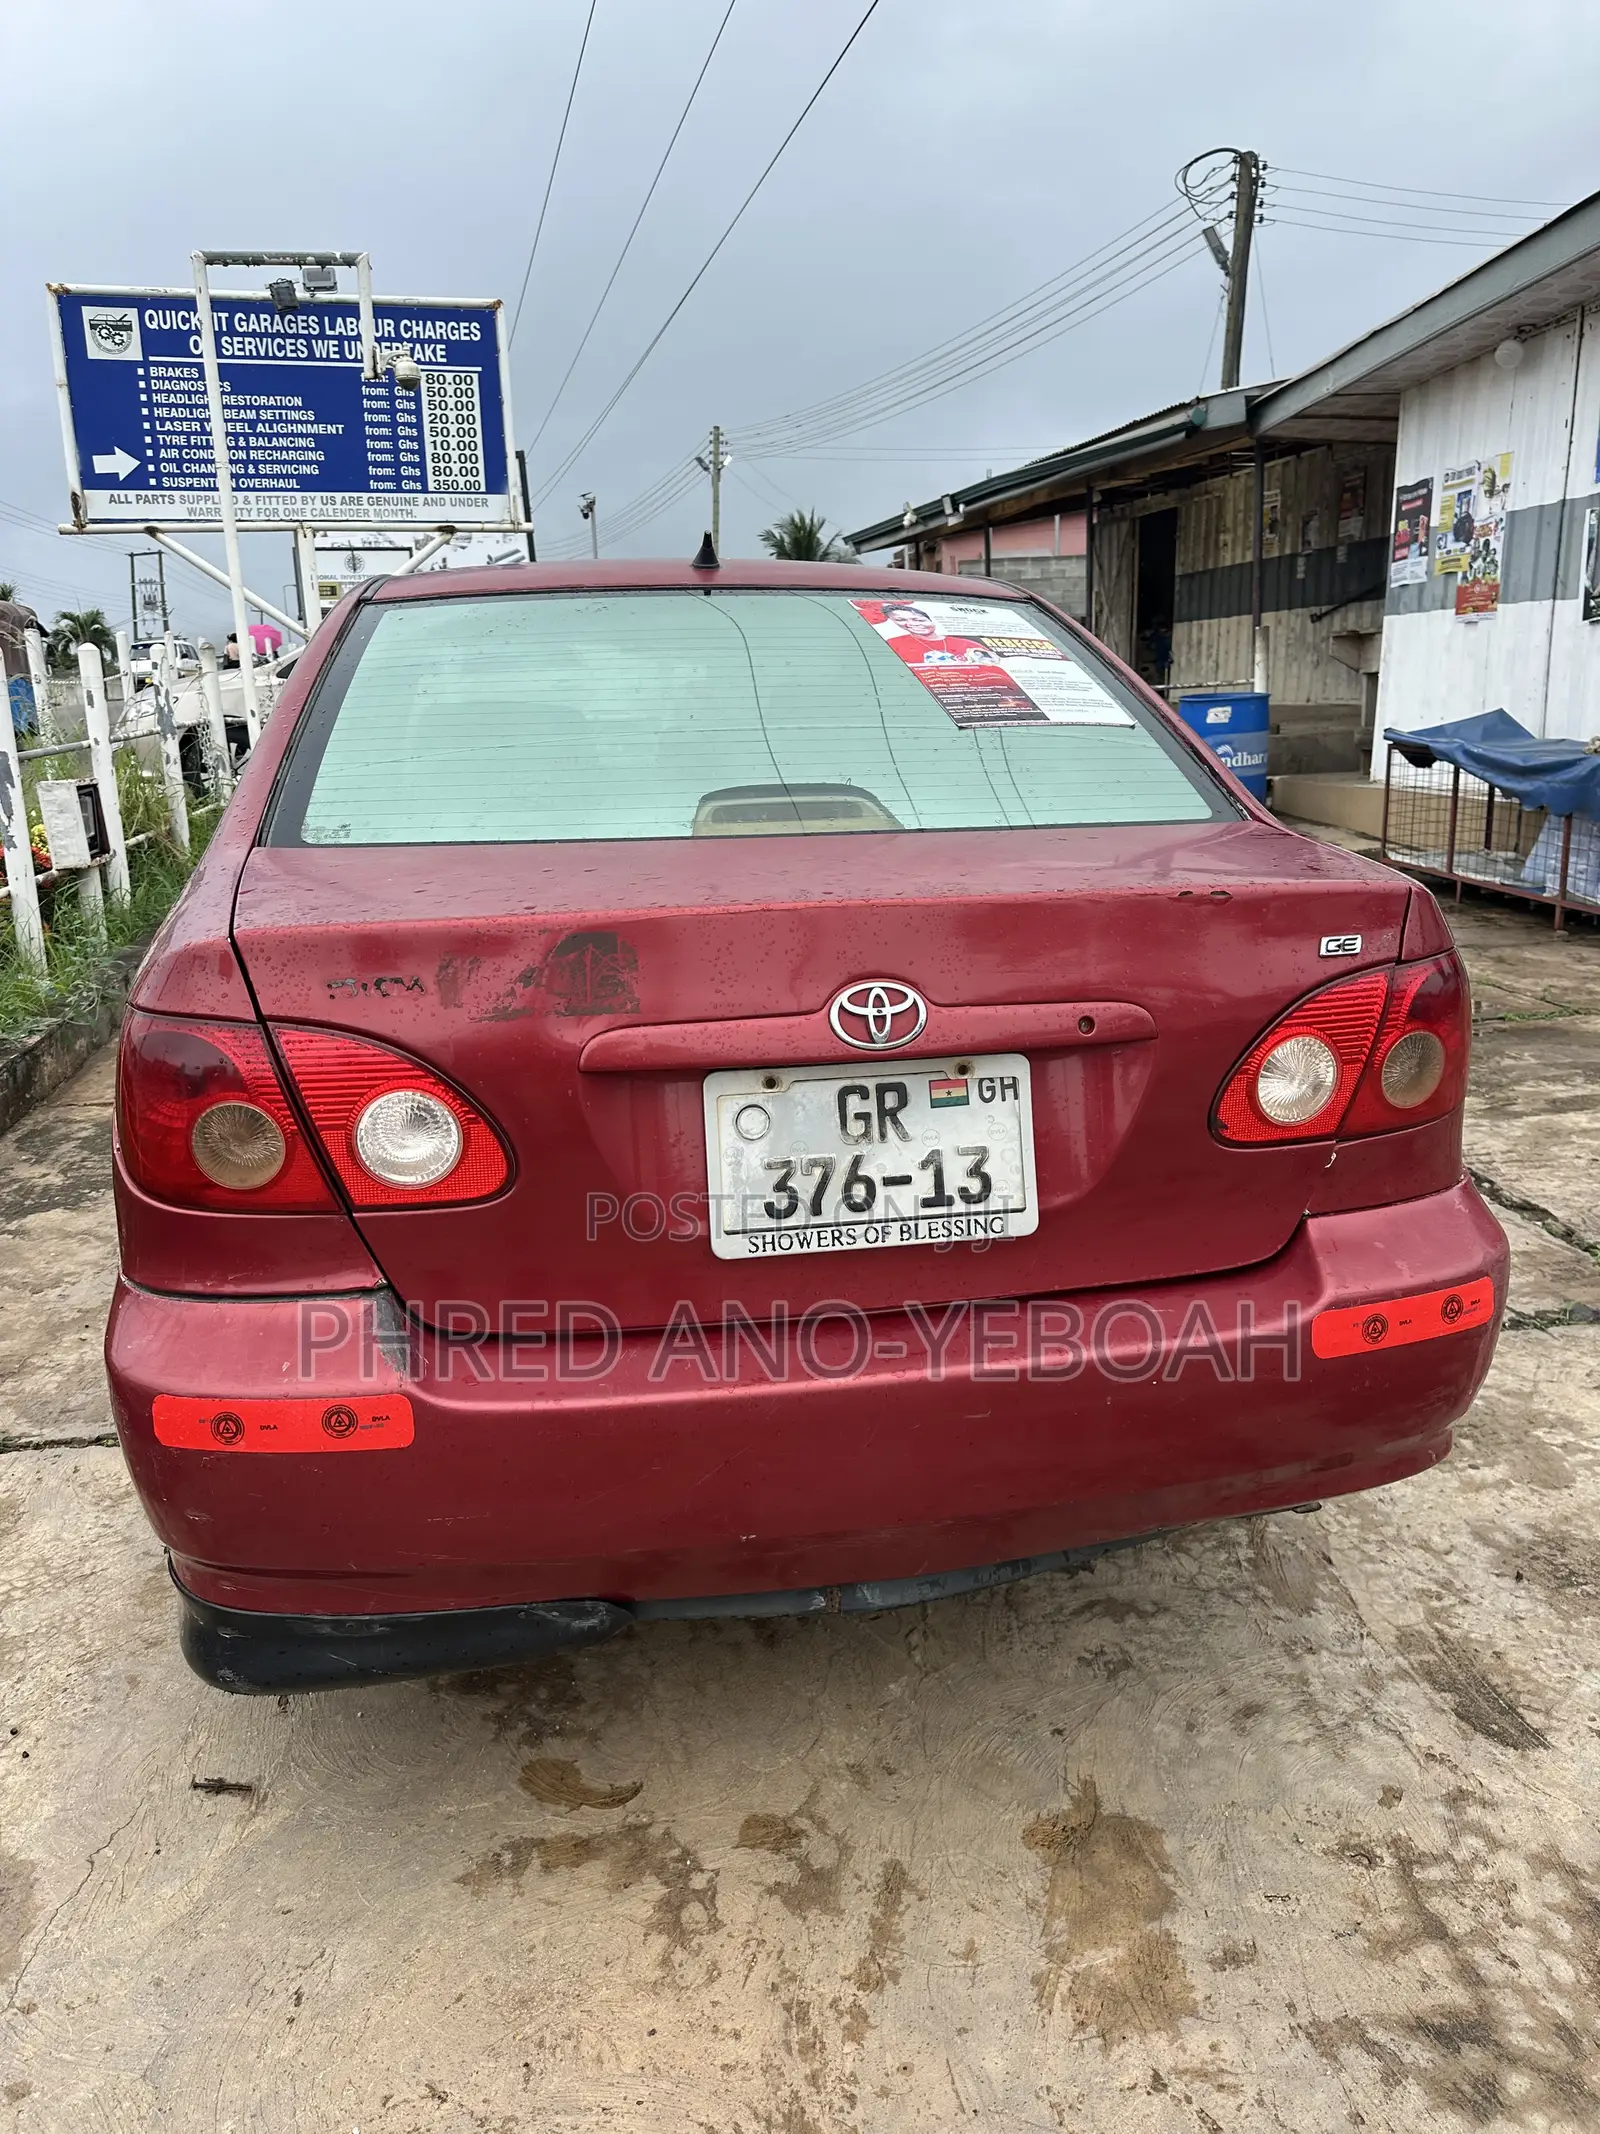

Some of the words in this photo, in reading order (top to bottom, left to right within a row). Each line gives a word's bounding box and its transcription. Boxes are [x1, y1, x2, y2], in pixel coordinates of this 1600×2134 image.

[144, 309, 229, 332] QUICKIT
[233, 312, 320, 335] GARAGES
[324, 316, 395, 338] LABUR
[400, 319, 481, 342] CHARGES
[189, 335, 206, 355] O
[221, 336, 308, 359] SERVICES
[312, 339, 341, 360] WE
[149, 366, 199, 378] BRAKES
[425, 373, 474, 386] 80.00
[361, 386, 389, 396] from:
[426, 387, 475, 398] 50.00
[152, 393, 210, 405] HEADLIGH
[222, 395, 302, 407] RESTORATION
[363, 399, 390, 409] from:
[395, 399, 416, 410] Ghs
[427, 400, 476, 412] 50.00
[154, 407, 212, 418] HEADLIGH
[223, 409, 256, 420] BEAM
[259, 410, 315, 421] SETTINGS
[364, 412, 391, 423] from:
[396, 412, 417, 423] Ghs
[428, 413, 477, 425] 20.00
[156, 420, 201, 431] LASER
[256, 423, 345, 434] ALIGHNMENT
[365, 425, 392, 436] from:
[397, 425, 418, 437] Ghs
[429, 426, 478, 439] 50.00
[157, 435, 188, 446] TYRE
[190, 436, 236, 447] FITTG
[238, 437, 247, 447] &
[248, 437, 316, 448] BALANCING
[366, 439, 393, 449] from:
[398, 439, 419, 450] Ghs
[430, 440, 478, 452] 10.00
[159, 448, 179, 459] AIR
[249, 450, 325, 461] RECHARGING
[367, 452, 394, 462] from:
[399, 452, 420, 463] Ghs
[431, 453, 479, 465] 80.00
[160, 463, 181, 473] OIL
[183, 463, 245, 474] CHANNG
[247, 464, 256, 474] &
[258, 464, 319, 475] SERVICING
[368, 466, 395, 476] from:
[400, 466, 421, 477] Ghs
[432, 466, 480, 478] 80.00
[162, 477, 236, 488] SUSPENTIN
[238, 478, 301, 489] OVERHAUL
[369, 480, 397, 490] from:
[401, 480, 422, 490] Ghs
[433, 479, 482, 491] 350.00
[108, 493, 133, 505] ALL
[135, 494, 175, 505] PARTS
[179, 494, 239, 506] SUPPLID
[243, 496, 251, 506] &
[255, 495, 297, 506] FITTED
[301, 496, 316, 506] BY
[320, 496, 337, 507] US
[340, 496, 364, 507] ARE
[367, 496, 420, 507] GENUINE
[422, 497, 446, 508] AND
[450, 497, 489, 508] UNDER
[187, 507, 253, 518] WARRTY
[256, 508, 280, 518] FOR
[283, 508, 307, 518] ONE
[310, 508, 370, 519] CALENDER
[373, 508, 417, 519] MONTH.
[837, 1082, 912, 1145] GR
[978, 1076, 1019, 1103] GH
[763, 1145, 993, 1220] 376-13
[748, 1227, 857, 1255] SHOWERS
[864, 1223, 892, 1245] OF
[899, 1216, 1005, 1242] BLESSING
